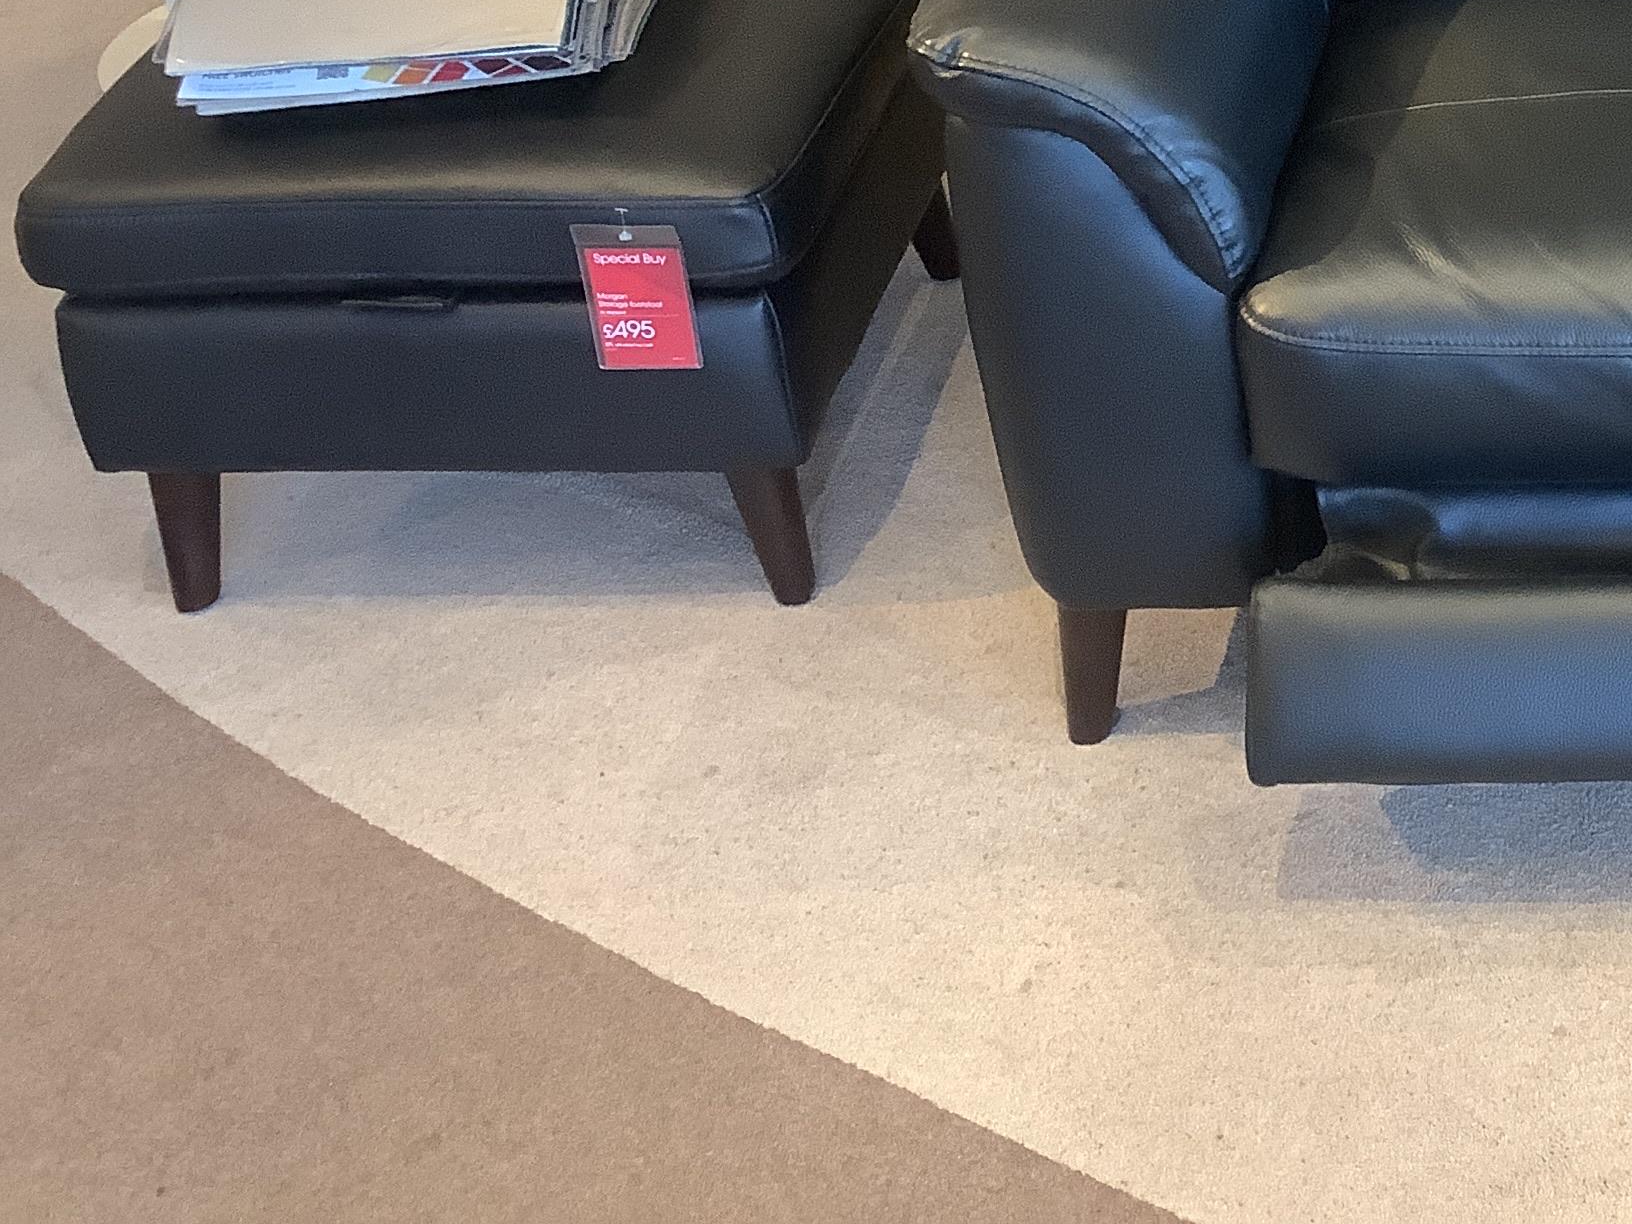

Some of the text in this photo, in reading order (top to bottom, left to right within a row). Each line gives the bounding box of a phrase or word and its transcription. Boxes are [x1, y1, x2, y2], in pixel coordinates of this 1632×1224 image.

[593, 253, 667, 266] Special Buy
[602, 320, 656, 339] £495
